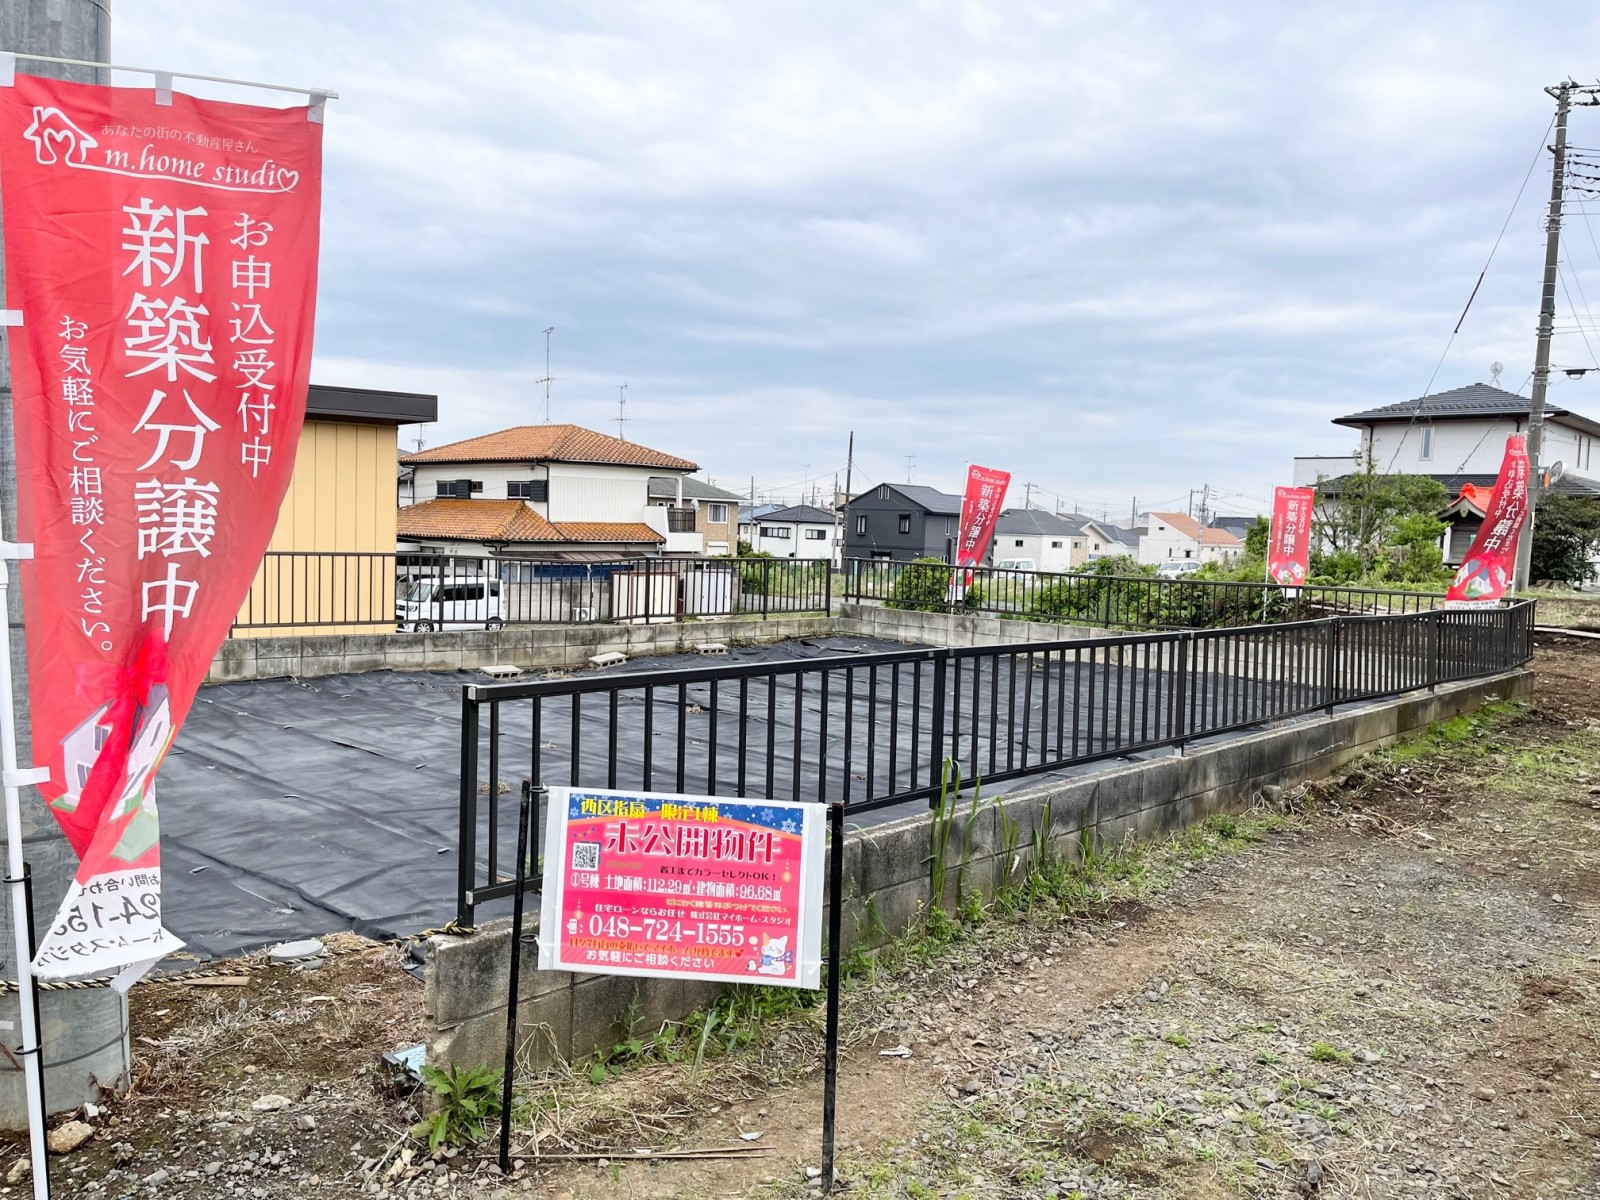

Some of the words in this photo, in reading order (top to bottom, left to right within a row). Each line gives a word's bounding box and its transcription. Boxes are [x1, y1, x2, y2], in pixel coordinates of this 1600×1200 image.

[102, 124, 258, 154] あなたの街の不動産屋さん
[105, 144, 205, 178] m.home
[229, 212, 276, 477] お申込受付中
[121, 197, 221, 643] 新築分譲中
[58, 315, 113, 653] お気軽にご相談ください。
[965, 483, 995, 552] 新築分譲中
[1283, 500, 1299, 556] 新築分譲中
[660, 803, 719, 823] 限定1棟
[604, 821, 781, 865] 未公開物件
[586, 950, 715, 969] お気軽にご相談ください
